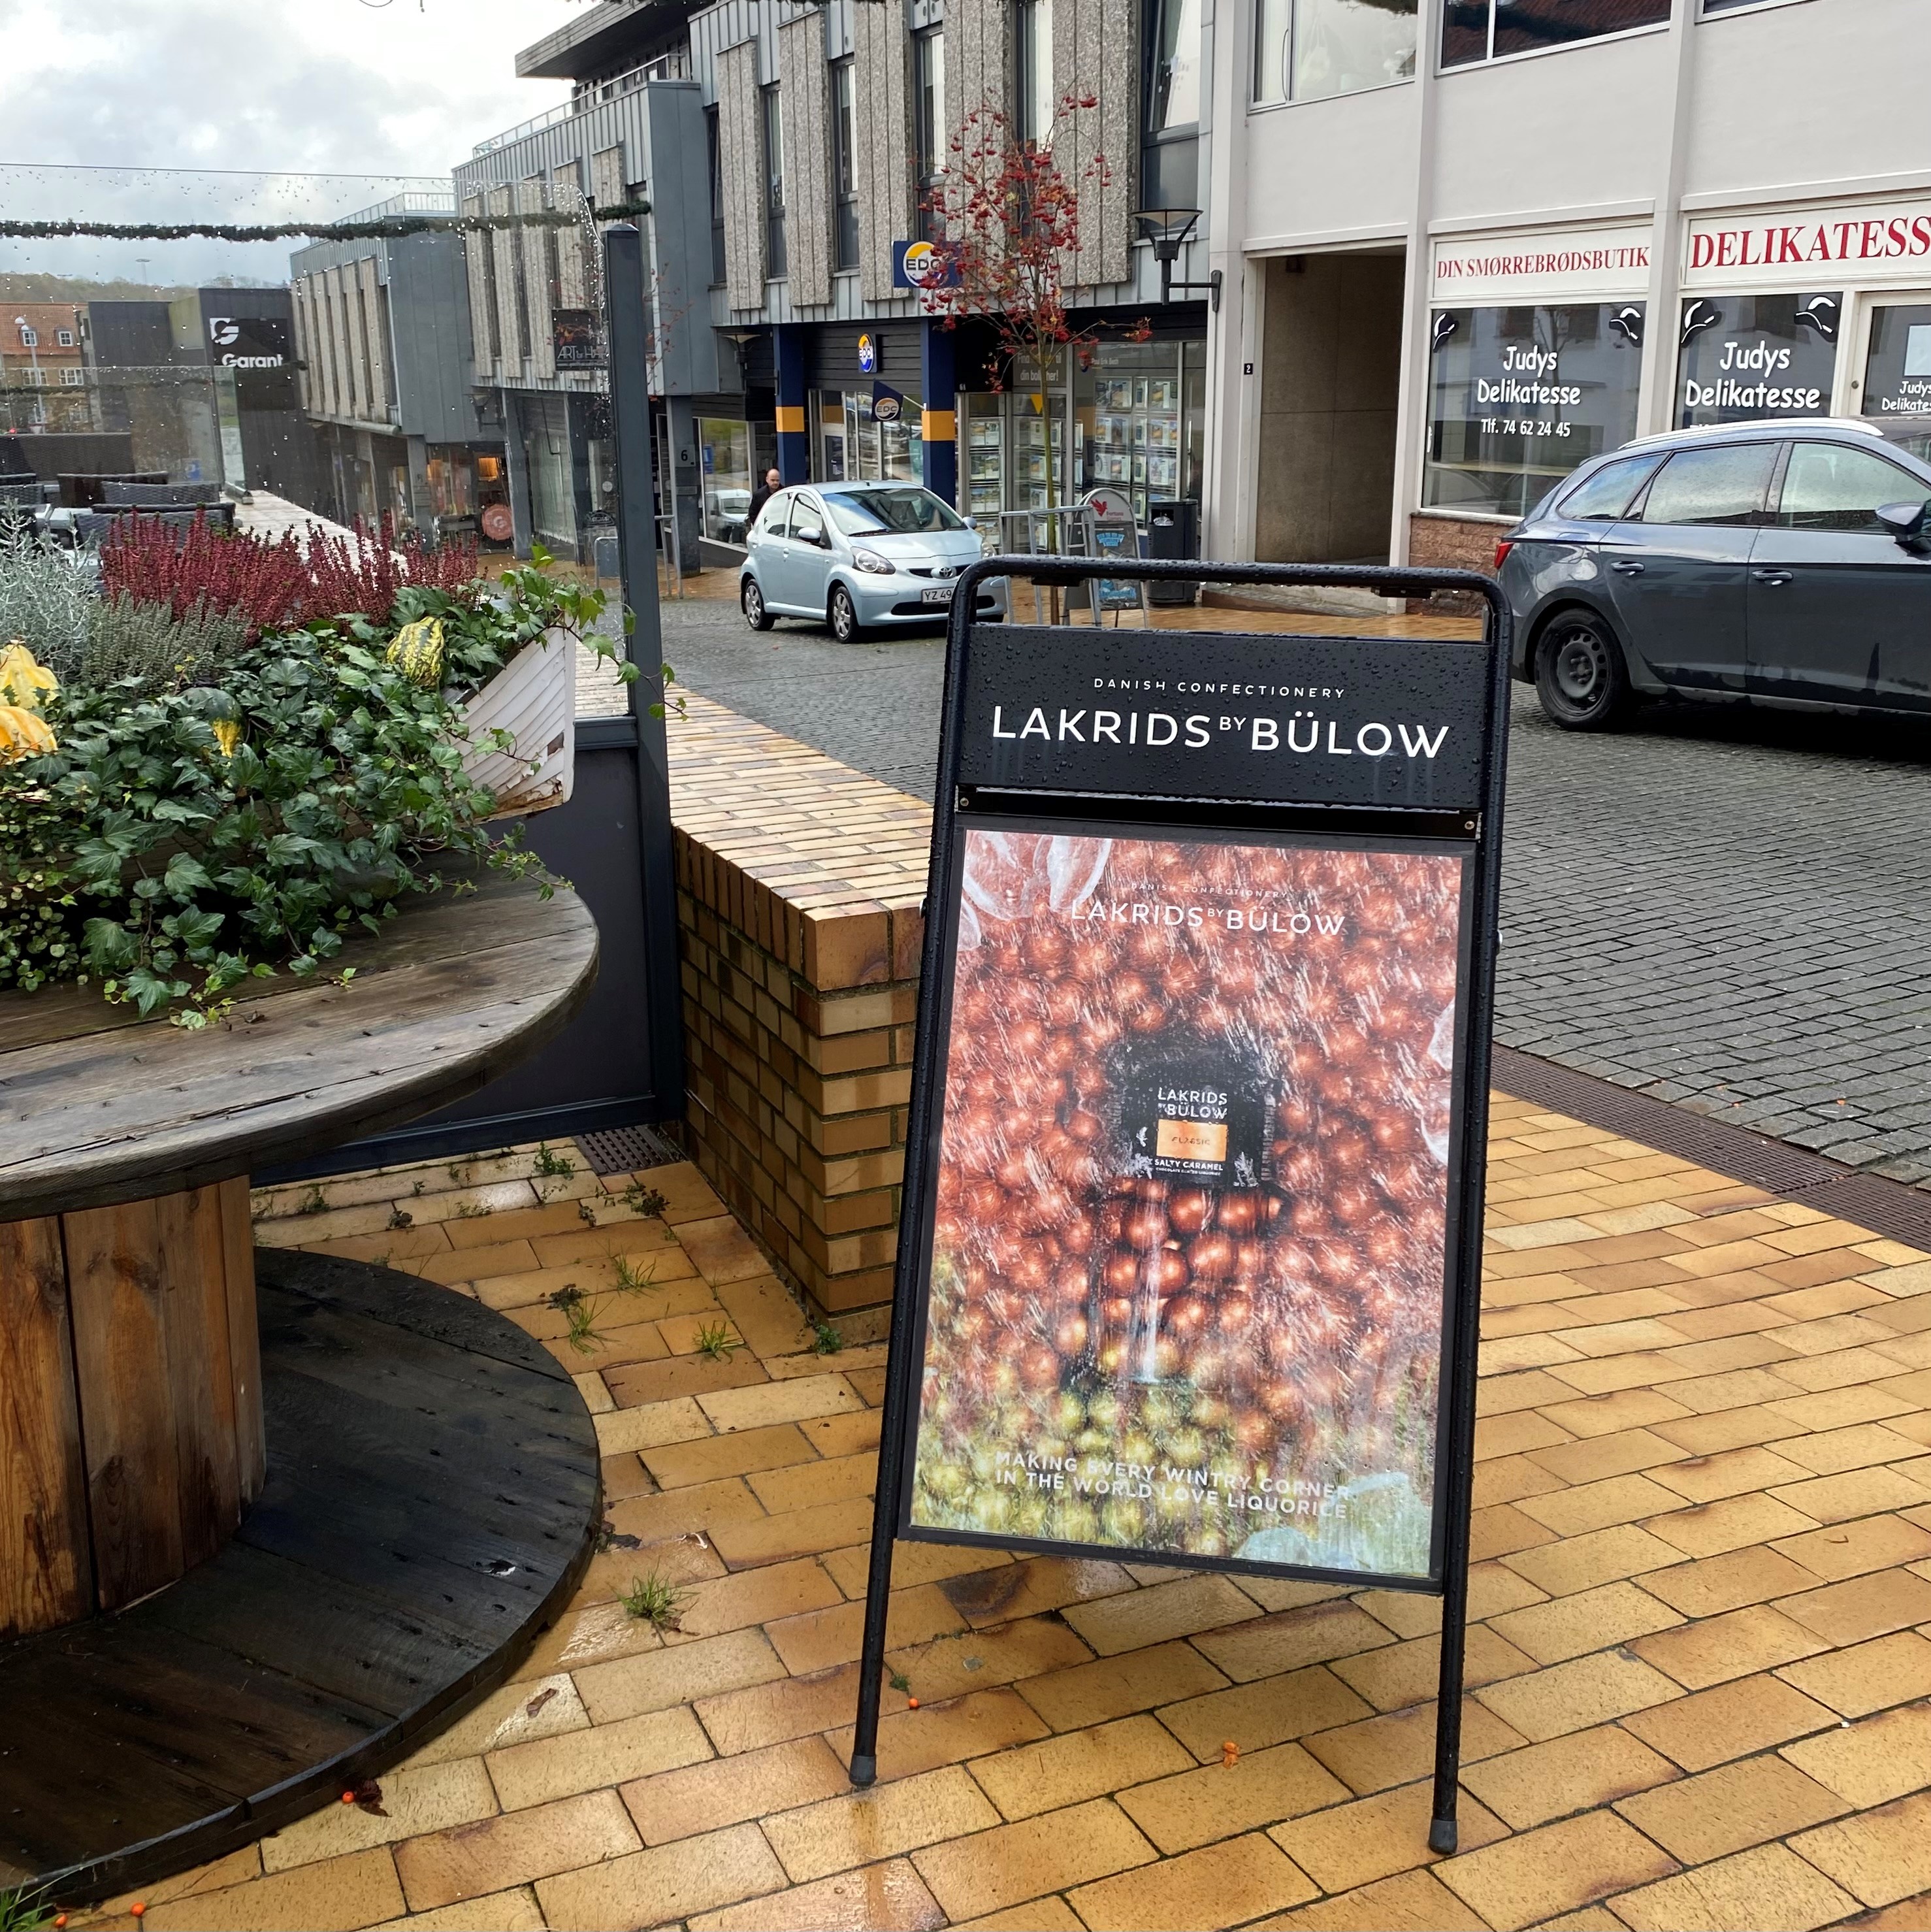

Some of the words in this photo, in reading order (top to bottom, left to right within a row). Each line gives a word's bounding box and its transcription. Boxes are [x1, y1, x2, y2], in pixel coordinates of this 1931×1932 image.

[1437, 259, 1464, 278] DIN
[1466, 246, 1651, 278] SMØRREBRØDSBUTIK
[221, 353, 284, 368] Garant
[1246, 364, 1251, 373] 2
[1503, 344, 1558, 378] Judys
[1719, 340, 1791, 378] Judys
[1478, 378, 1581, 405] Delikatesse
[1684, 378, 1820, 409] Delikatesse
[1480, 418, 1499, 434] Tlf.
[1503, 419, 1516, 434] 74
[1520, 420, 1533, 436] 62
[1537, 421, 1552, 436] 24
[1555, 422, 1571, 437] 45
[681, 450, 688, 461] 6
[924, 591, 938, 600] YZ
[1094, 678, 1167, 691] DANISH
[1177, 681, 1345, 699] CONFECTIONERY
[992, 705, 1211, 748] LAKRIDS
[1219, 715, 1247, 731] BY
[1251, 710, 1450, 759] BÜLOW
[1131, 882, 1176, 892] DANISH
[1183, 886, 1288, 899] CONFECTIONERY
[1071, 899, 1204, 928] LAKRIDS
[1207, 908, 1225, 918] BY
[1226, 906, 1346, 936] BÜLOW
[1158, 1087, 1228, 1105] LAKRIDS
[1165, 1102, 1228, 1119] BÜLOW
[1154, 1159, 1180, 1168] SALTY
[1182, 1161, 1223, 1171] CARAMEL
[996, 1450, 1078, 1473] MAKING
[1087, 1457, 1156, 1481] EVERY
[1165, 1466, 1252, 1491] WINTRY
[1260, 1477, 1351, 1501] CORNER
[996, 1469, 1017, 1485] IN
[1026, 1471, 1065, 1490] THE
[1073, 1476, 1152, 1499] WORLD
[1161, 1486, 1218, 1505] LOVE
[1227, 1493, 1347, 1519] LIQUORICE
